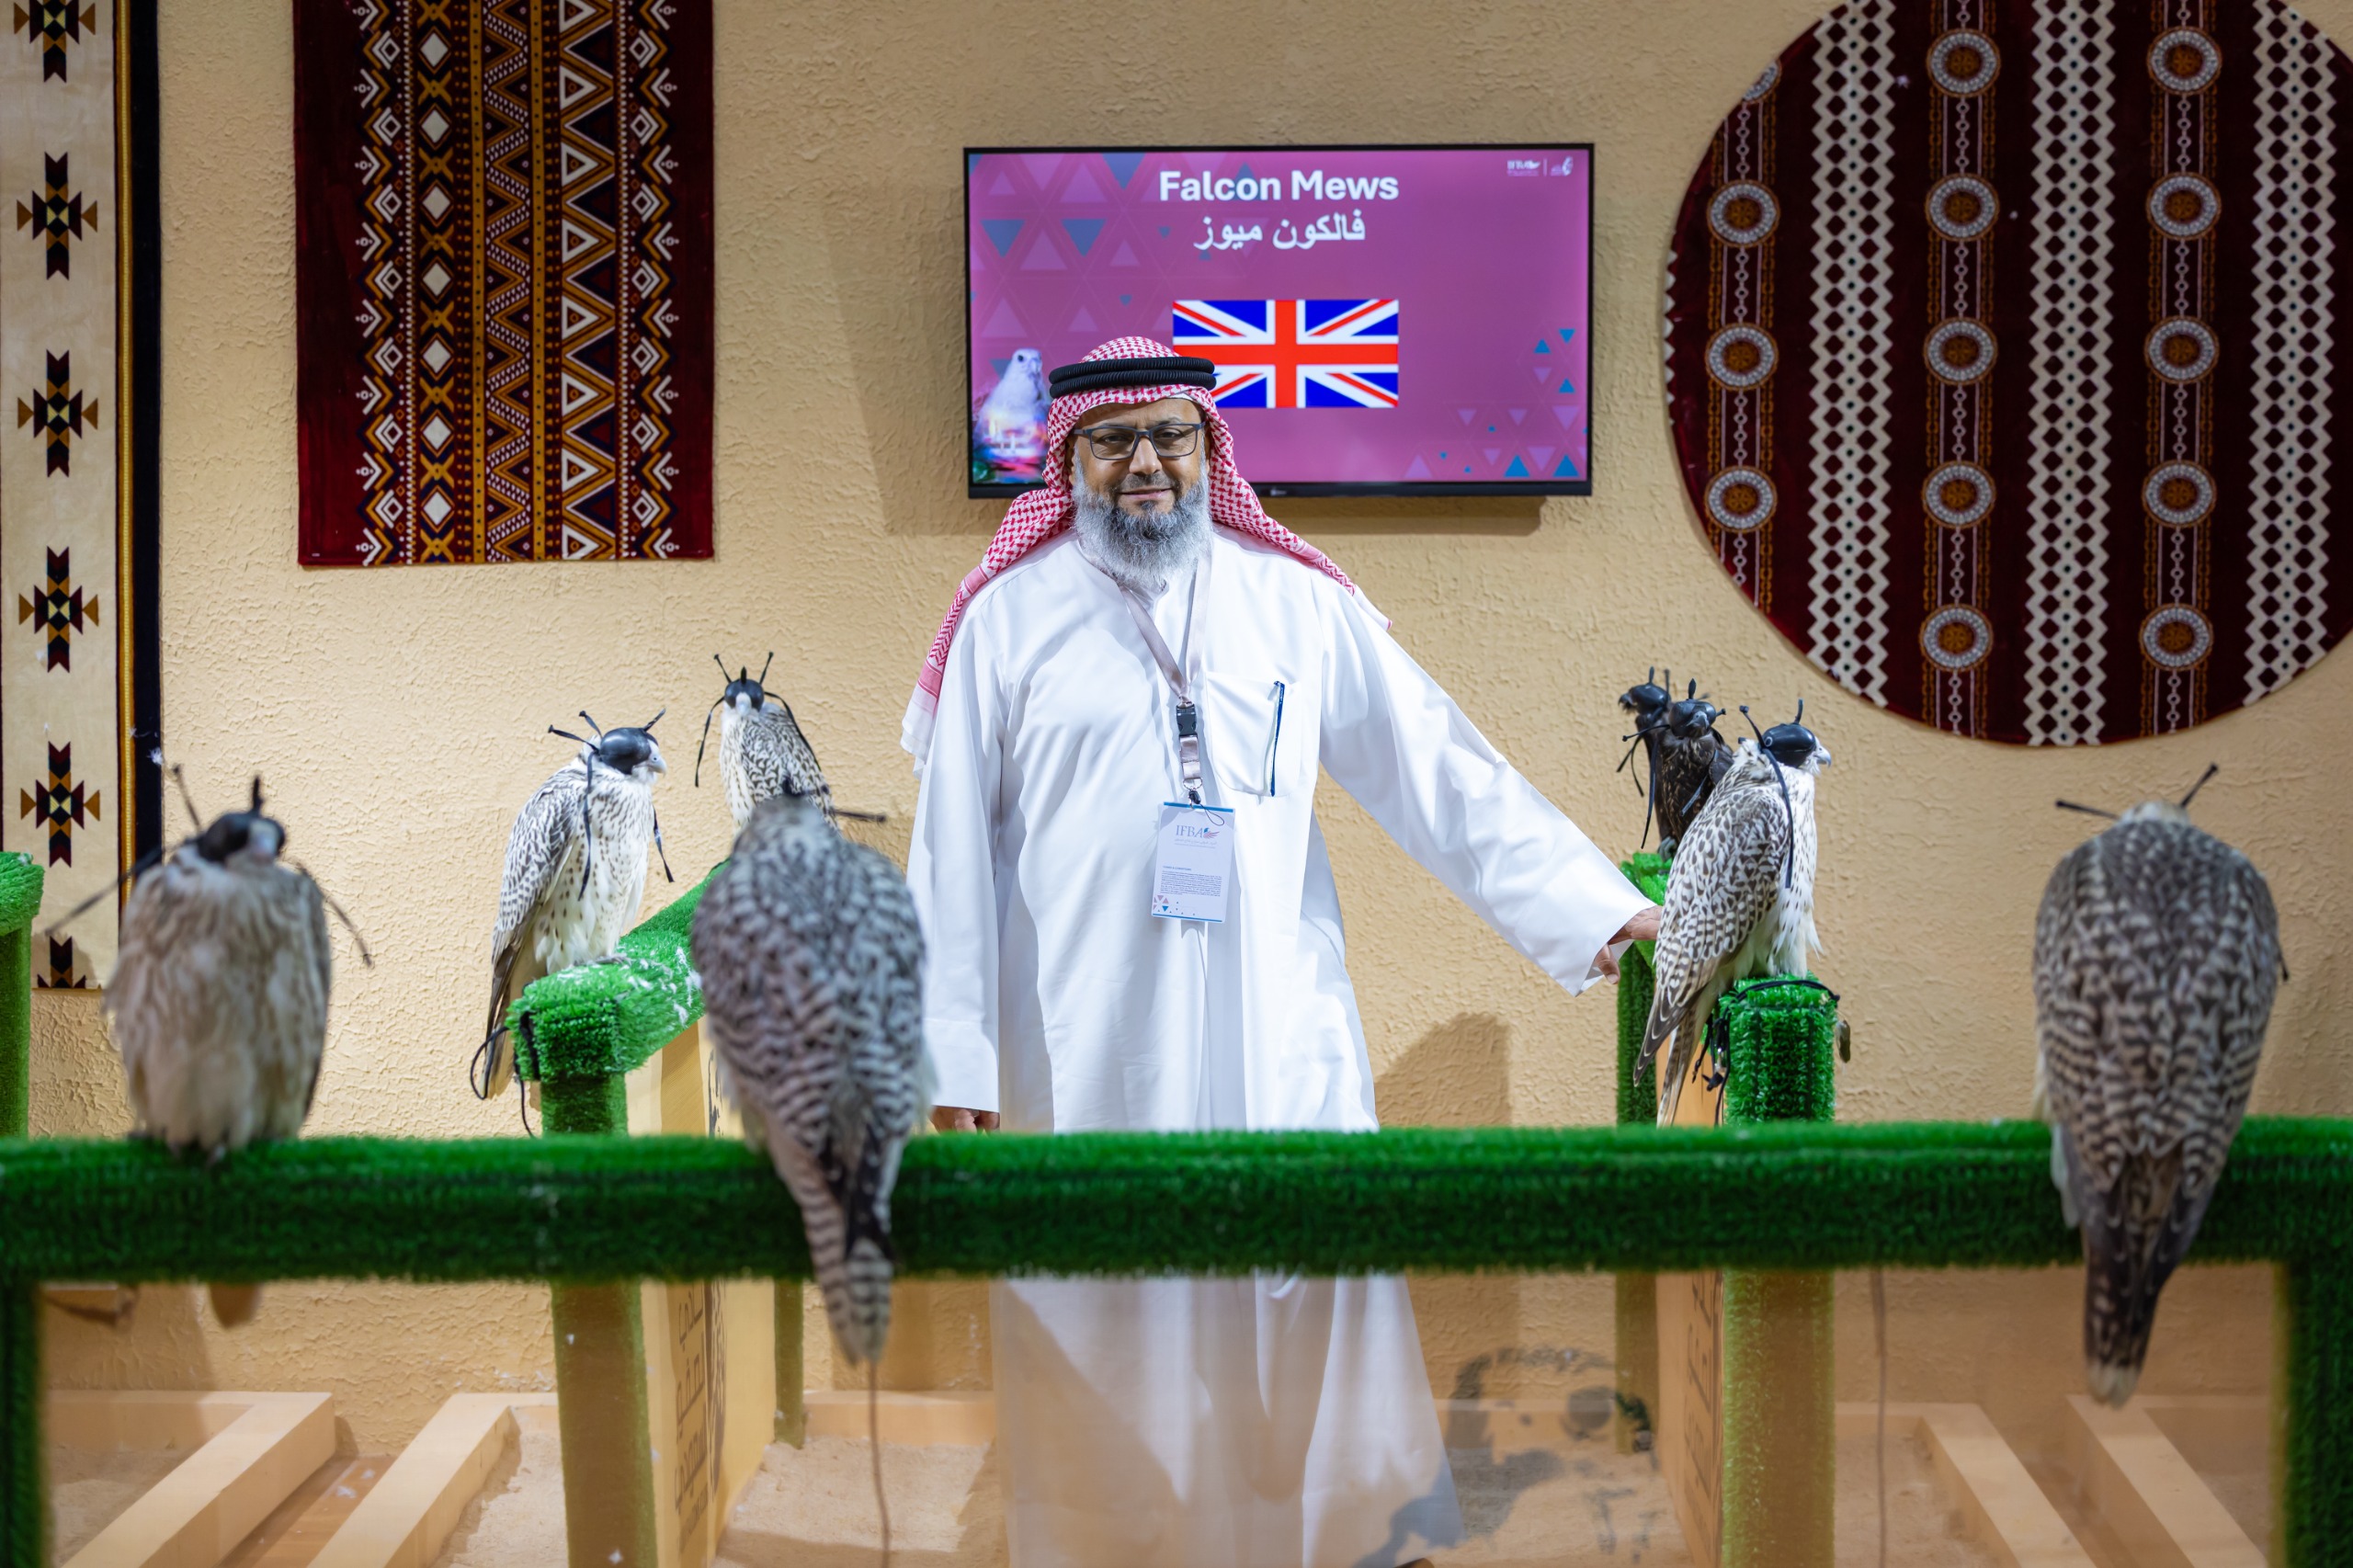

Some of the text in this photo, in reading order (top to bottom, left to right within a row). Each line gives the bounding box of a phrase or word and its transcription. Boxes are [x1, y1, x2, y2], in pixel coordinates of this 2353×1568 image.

[1159, 169, 1399, 201] Falcon Mews
[1193, 209, 1366, 251] فالكون ميوز
[1176, 824, 1203, 838] IFBA
